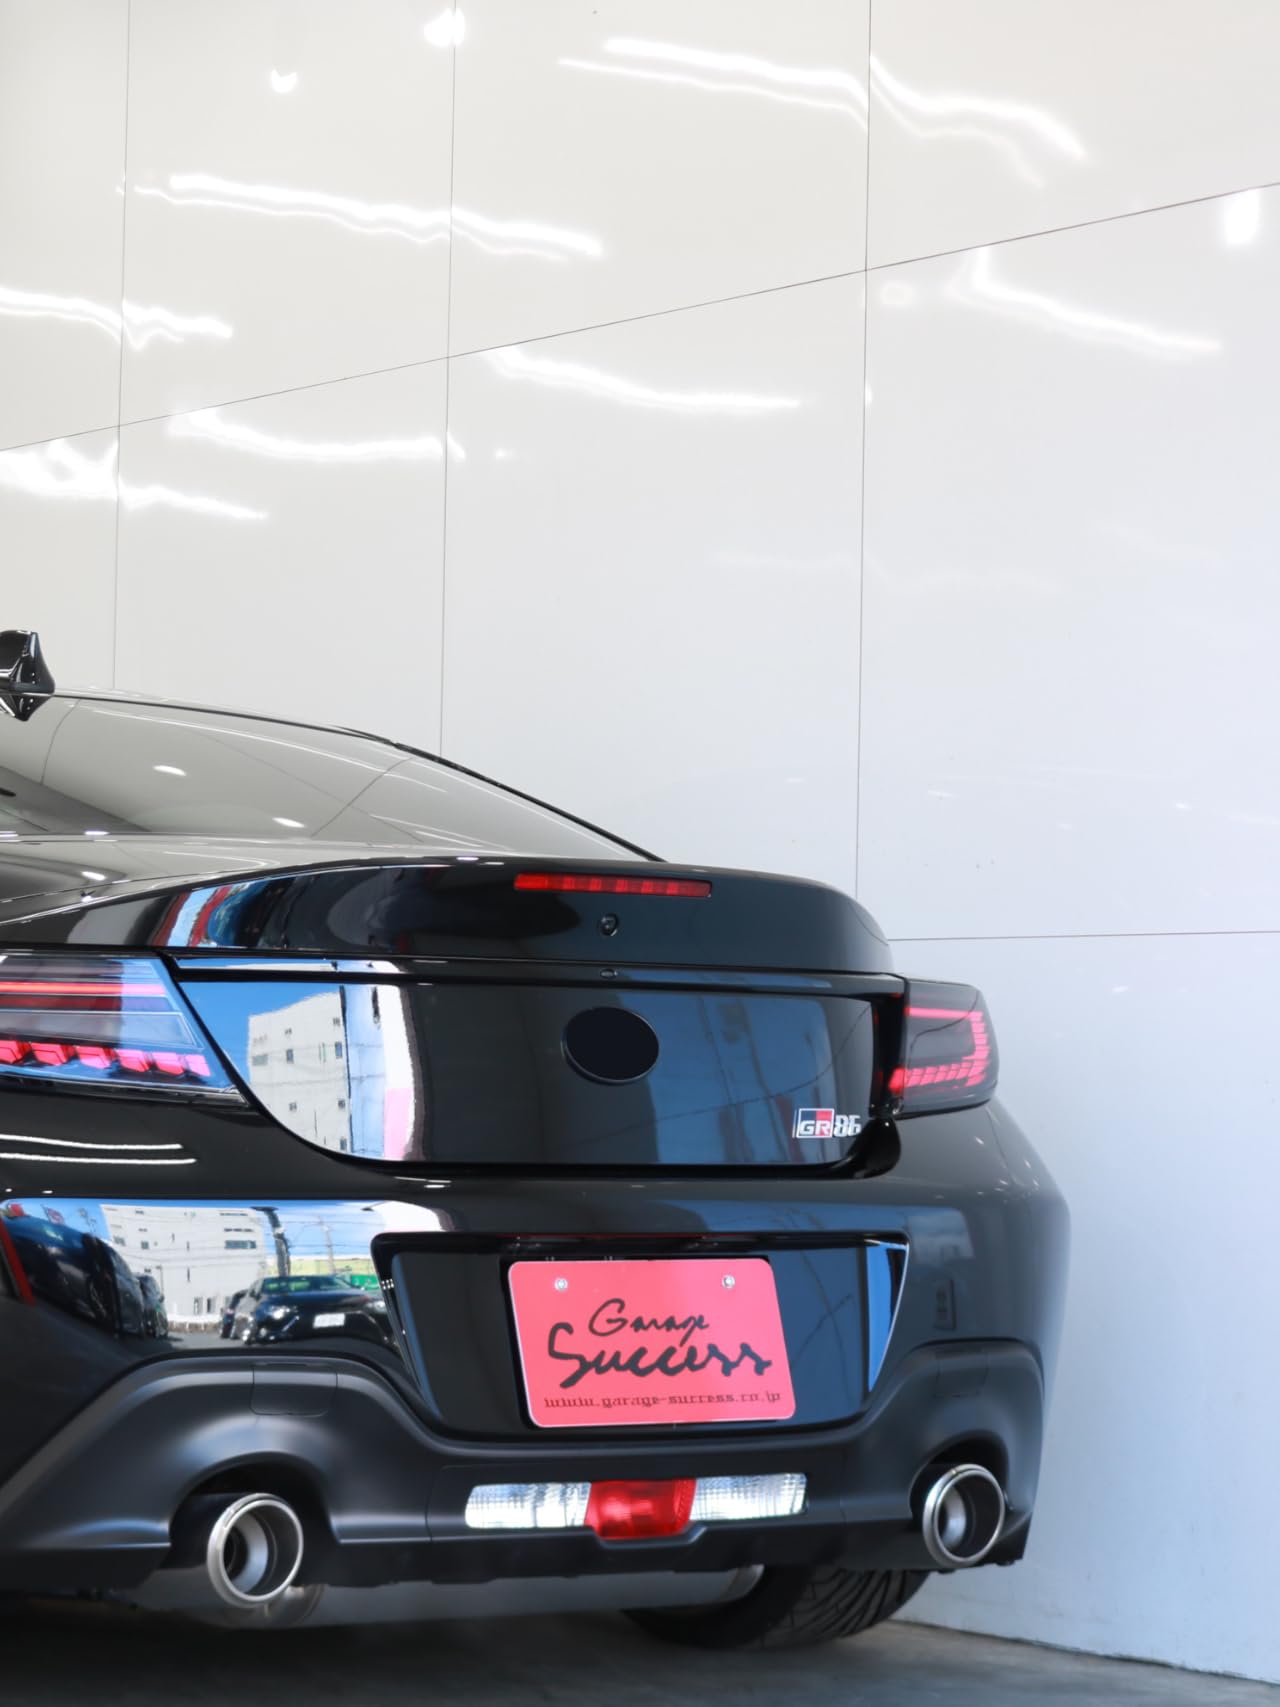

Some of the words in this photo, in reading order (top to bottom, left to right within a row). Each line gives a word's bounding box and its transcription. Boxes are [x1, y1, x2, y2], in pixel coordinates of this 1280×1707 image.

[588, 1298, 709, 1347] Garage
[547, 1322, 772, 1389] Success
[543, 1390, 781, 1408] www.garage-success.co.jp
